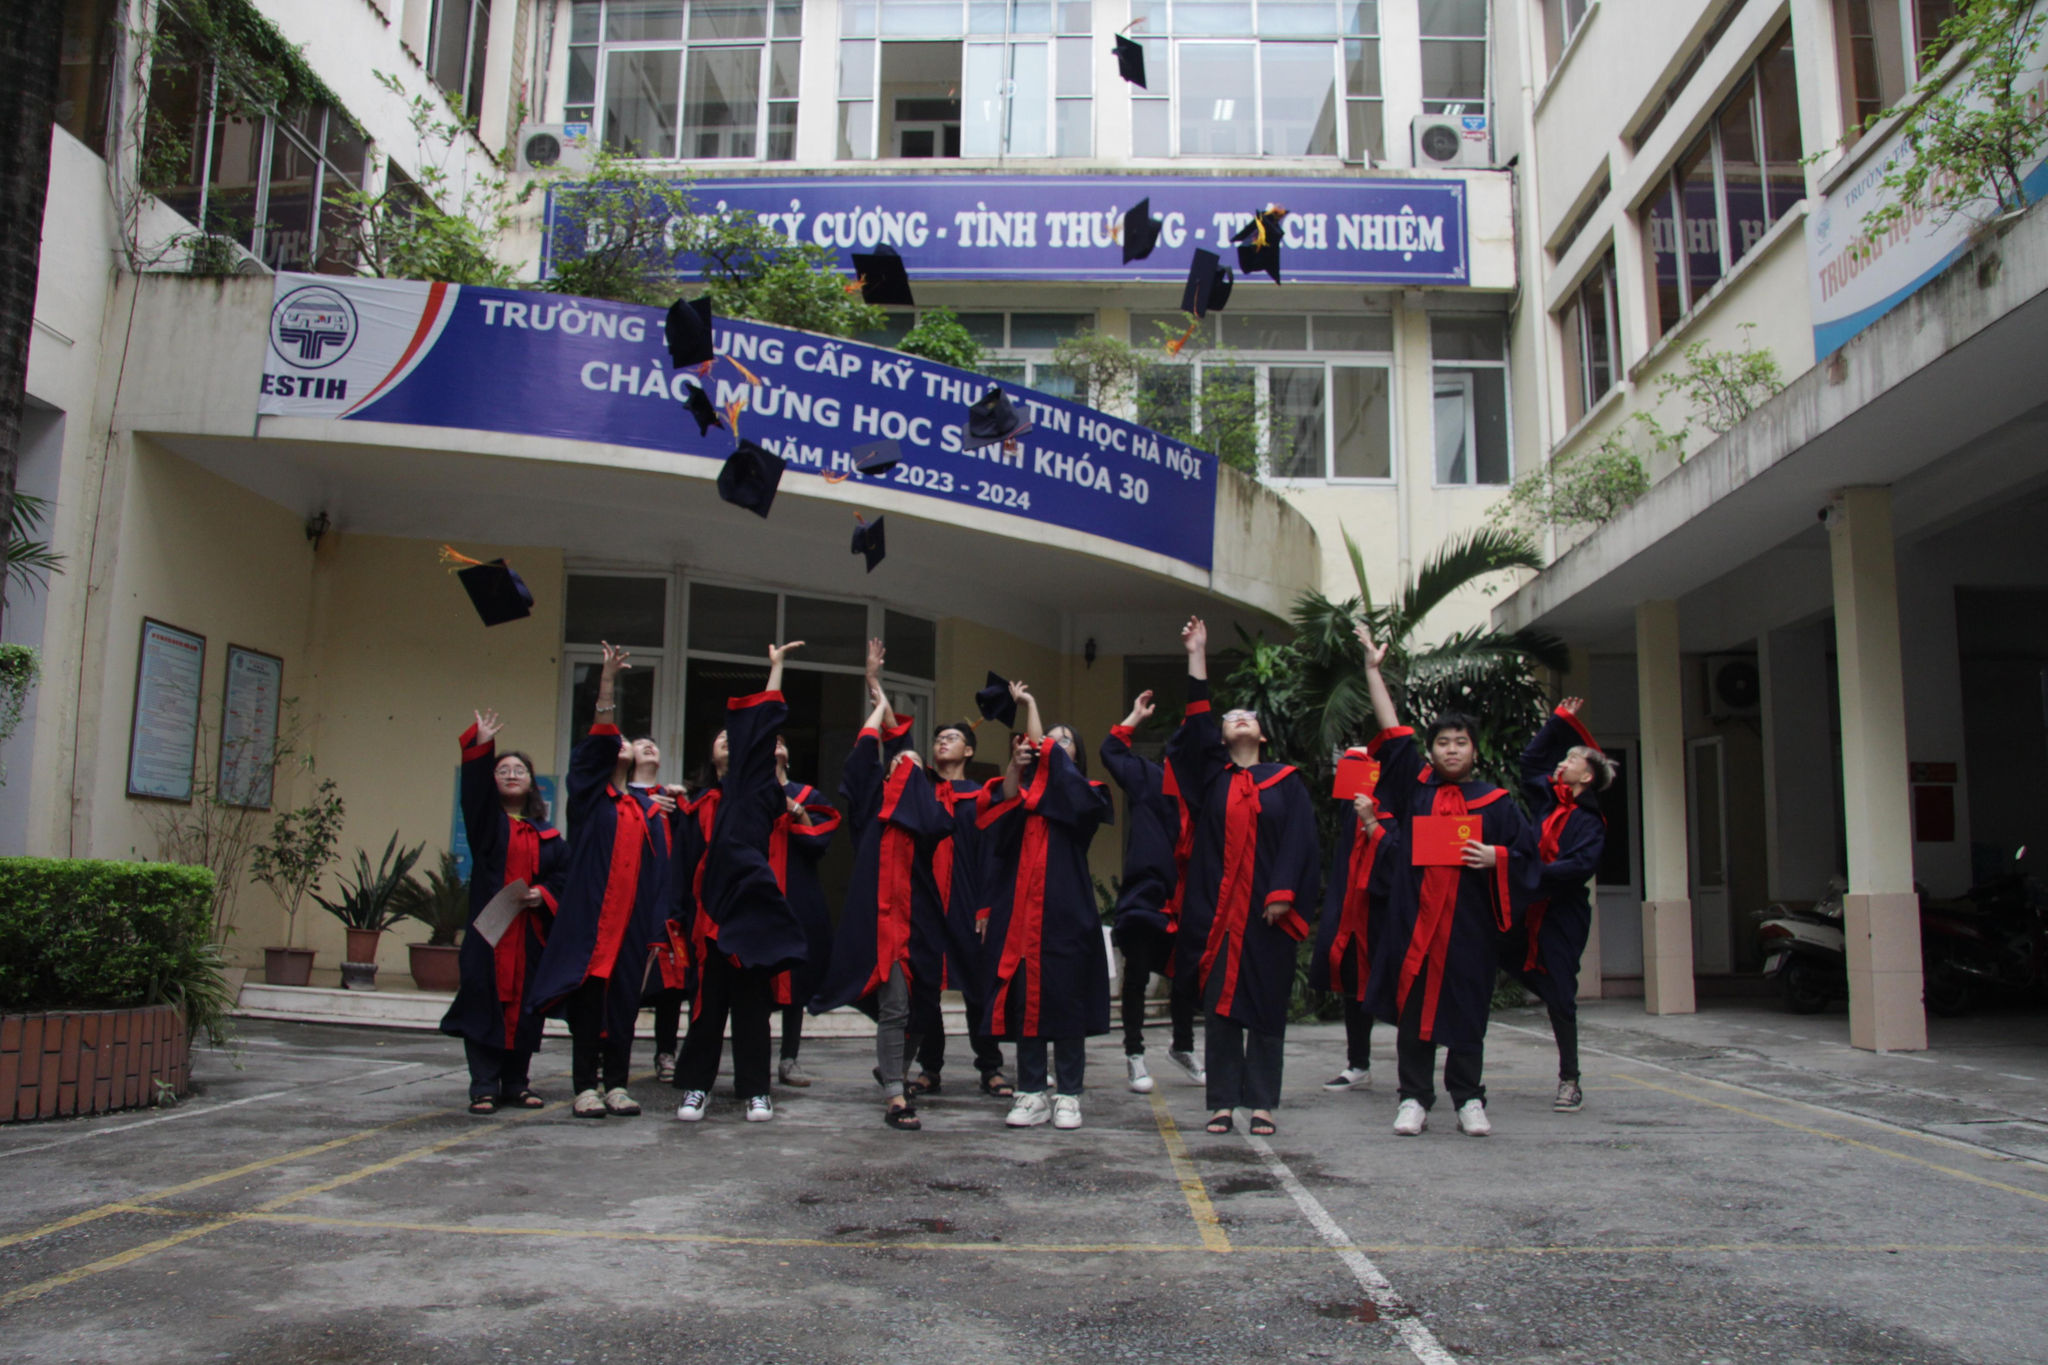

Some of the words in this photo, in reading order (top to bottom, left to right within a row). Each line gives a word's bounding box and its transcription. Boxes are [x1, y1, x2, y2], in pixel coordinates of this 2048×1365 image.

[812, 205, 929, 248] CƯƠNG
[954, 201, 1037, 248] TÌNH
[1336, 204, 1445, 262] NHIỆM
[260, 373, 348, 400] ESTIH
[479, 299, 646, 342] TRƯỜNG
[794, 342, 863, 379] CẤP
[871, 359, 915, 391] KỸ
[1025, 399, 1071, 434] TIN
[1078, 416, 1127, 452] HỌC
[1132, 433, 1161, 465] HÀ
[1165, 446, 1202, 480] NỘI
[580, 358, 702, 404] CHÀO
[715, 375, 841, 428] MỪNG
[1034, 452, 1112, 494] KHÓA
[1119, 472, 1149, 504] 30
[761, 436, 822, 468] NĂM
[894, 462, 954, 493] 2023
[976, 480, 1031, 511] 2024
